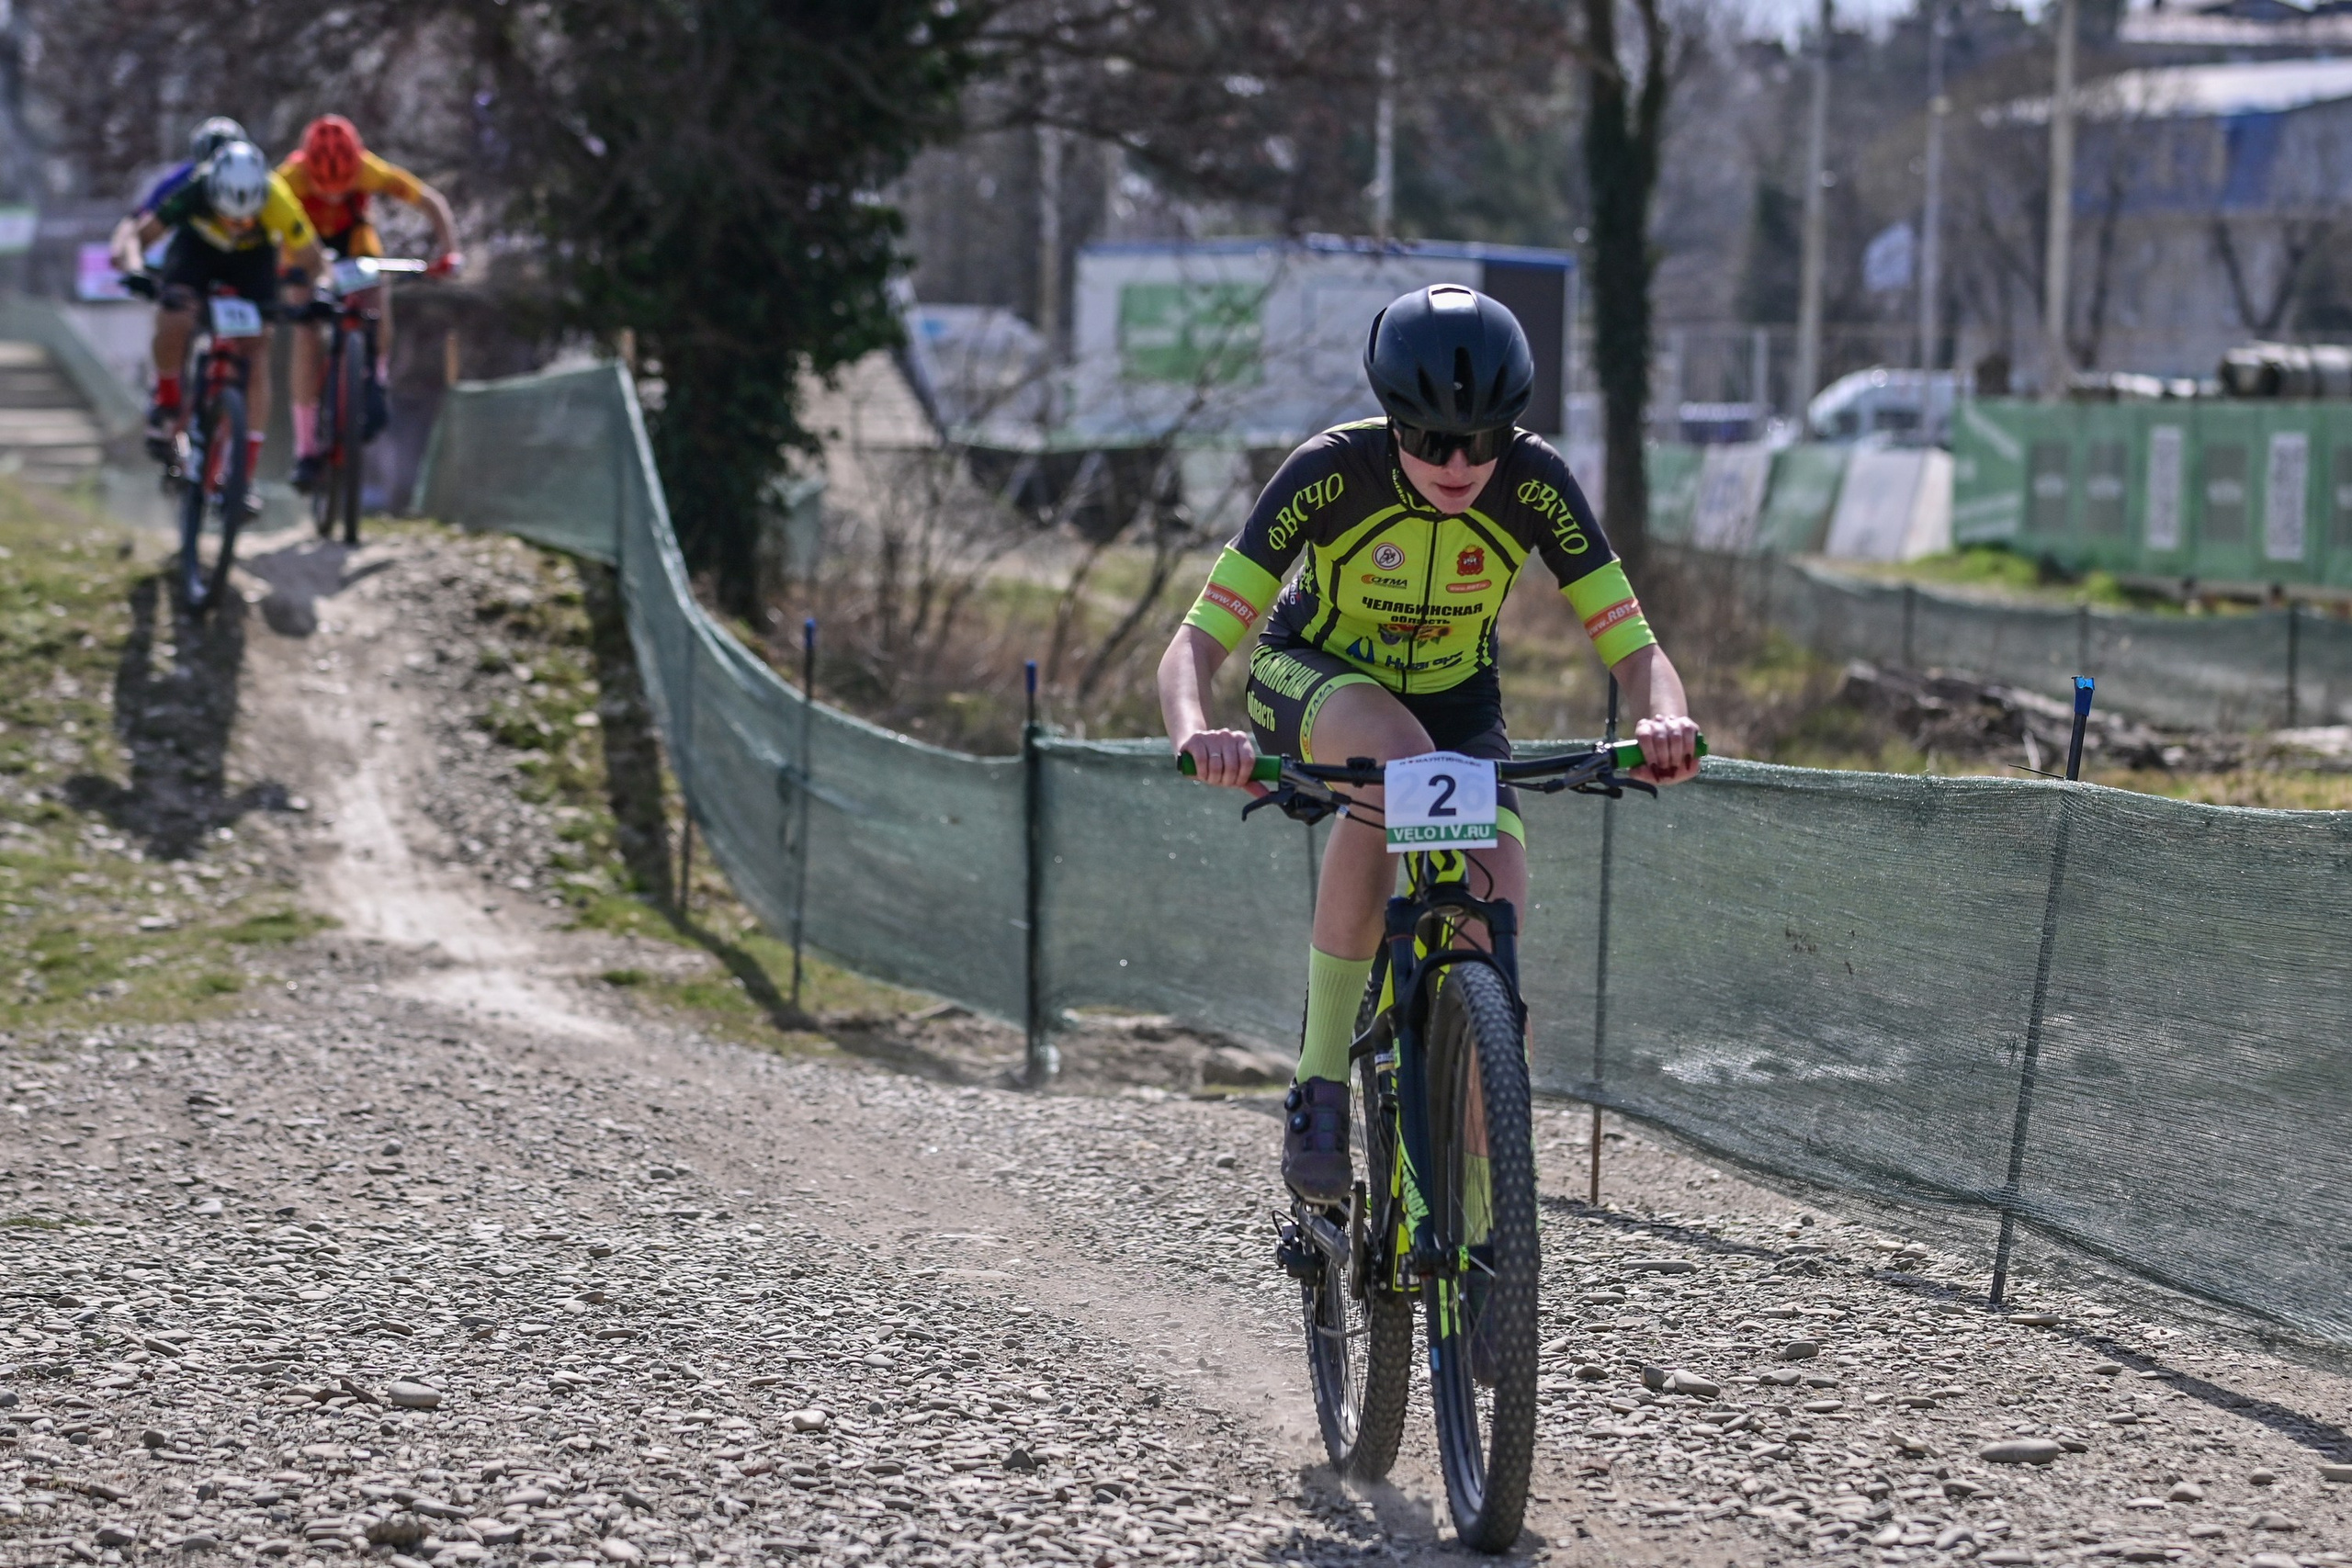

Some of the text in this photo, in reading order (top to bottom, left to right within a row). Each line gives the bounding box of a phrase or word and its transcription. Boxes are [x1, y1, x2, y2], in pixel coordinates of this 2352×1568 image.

[1268, 472, 1344, 551] ФВСЧО
[1362, 596, 1484, 616] ЧЕЛЯБИНСКАЯ
[1428, 773, 1457, 818] 2
[1393, 824, 1490, 841] VELOTV.RU
